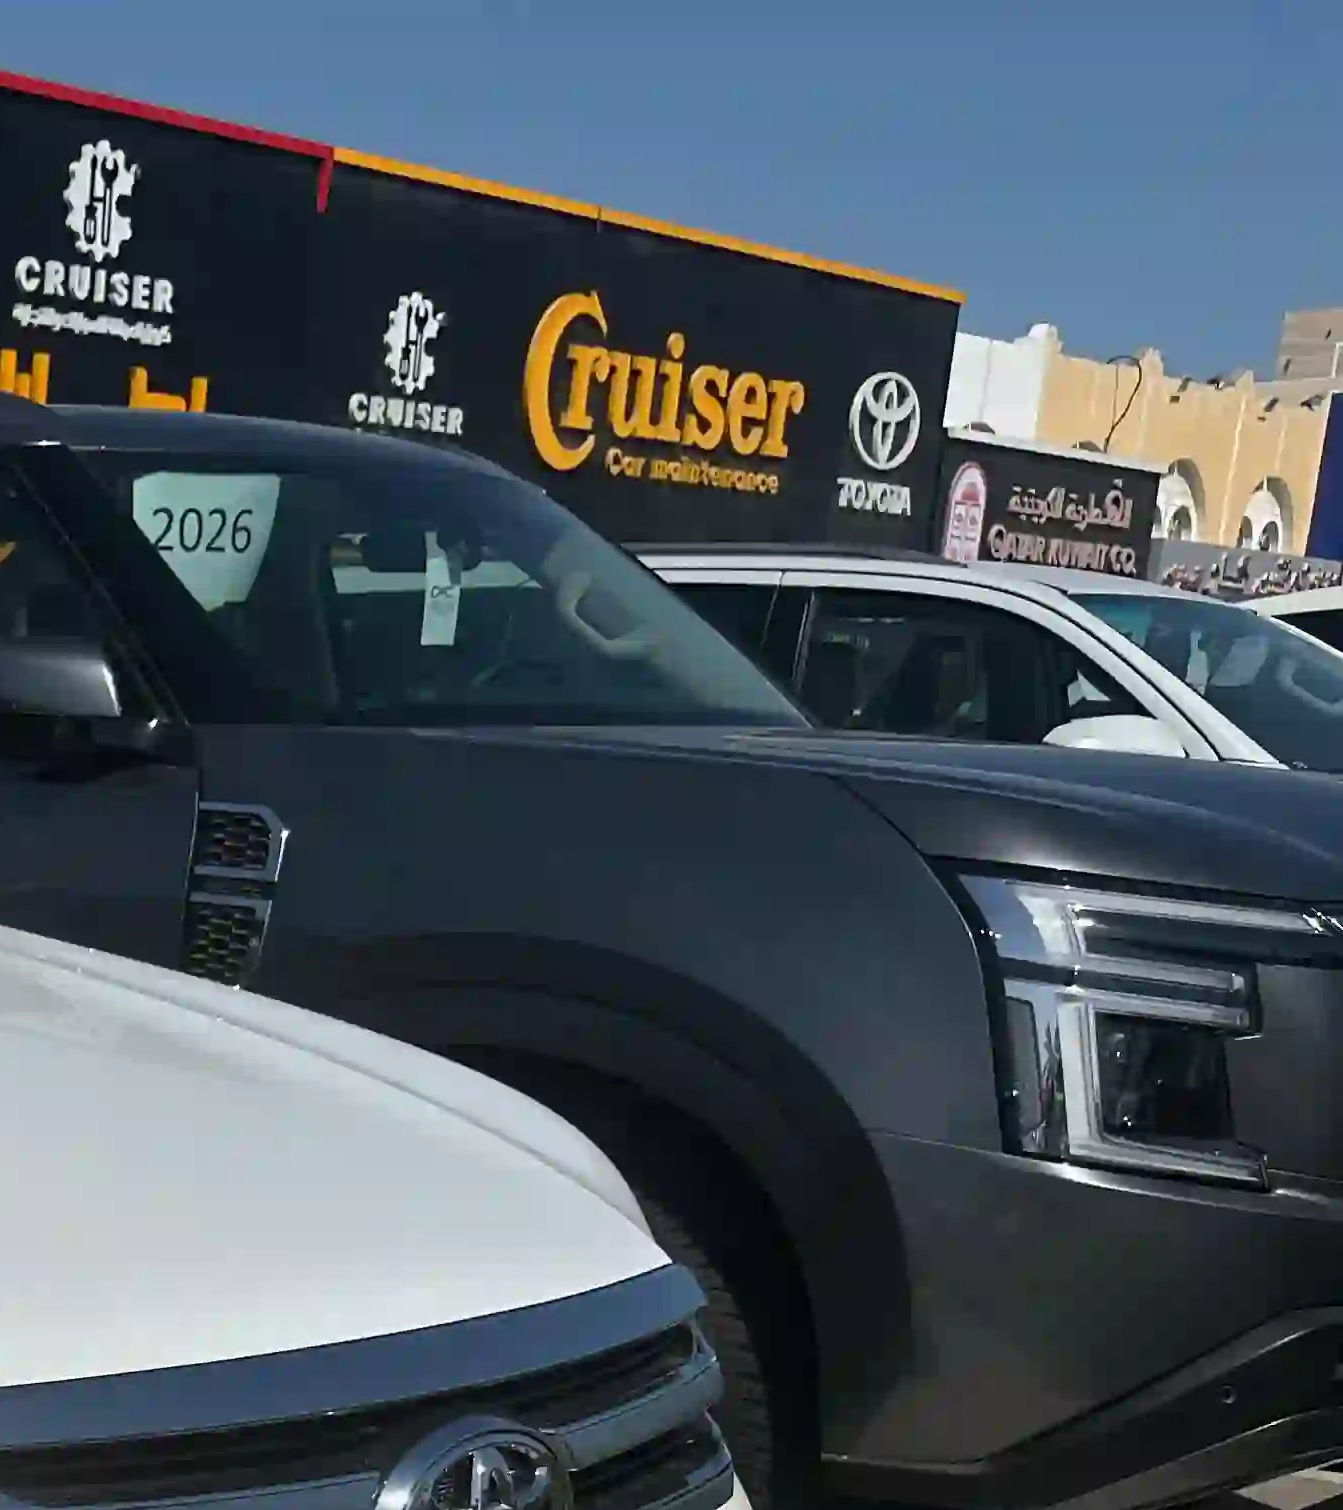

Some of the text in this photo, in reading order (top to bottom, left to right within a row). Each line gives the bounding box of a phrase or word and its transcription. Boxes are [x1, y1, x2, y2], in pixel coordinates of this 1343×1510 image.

[15, 256, 174, 313] CRUISER
[523, 290, 804, 471] Cruiser
[348, 392, 464, 436] CRUISER
[605, 447, 780, 495] Car maintenance
[837, 478, 912, 516] TOYOTA
[152, 507, 254, 554] 2026
[1048, 538, 1108, 570] KUWAIT
